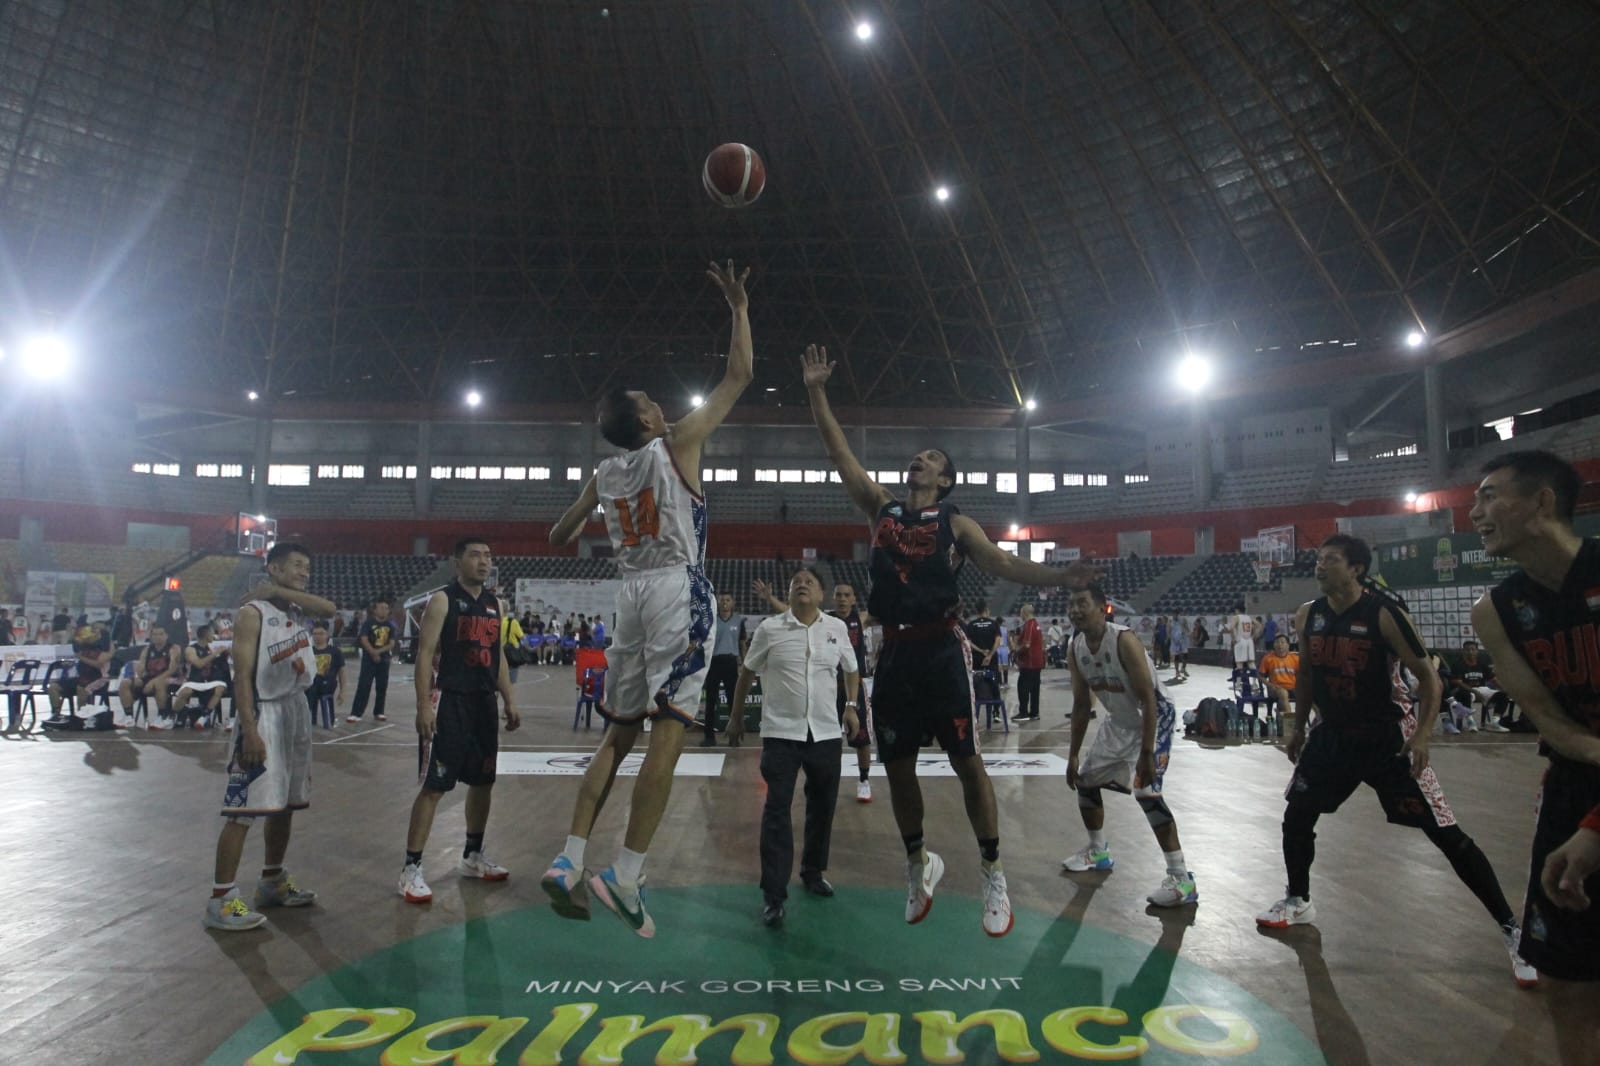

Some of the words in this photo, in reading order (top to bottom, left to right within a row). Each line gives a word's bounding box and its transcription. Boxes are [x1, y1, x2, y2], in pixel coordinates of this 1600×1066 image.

[954, 718, 969, 741] 7
[525, 980, 684, 994] MINYAK
[700, 978, 884, 993] GORENG
[899, 976, 1023, 992] SAWIT
